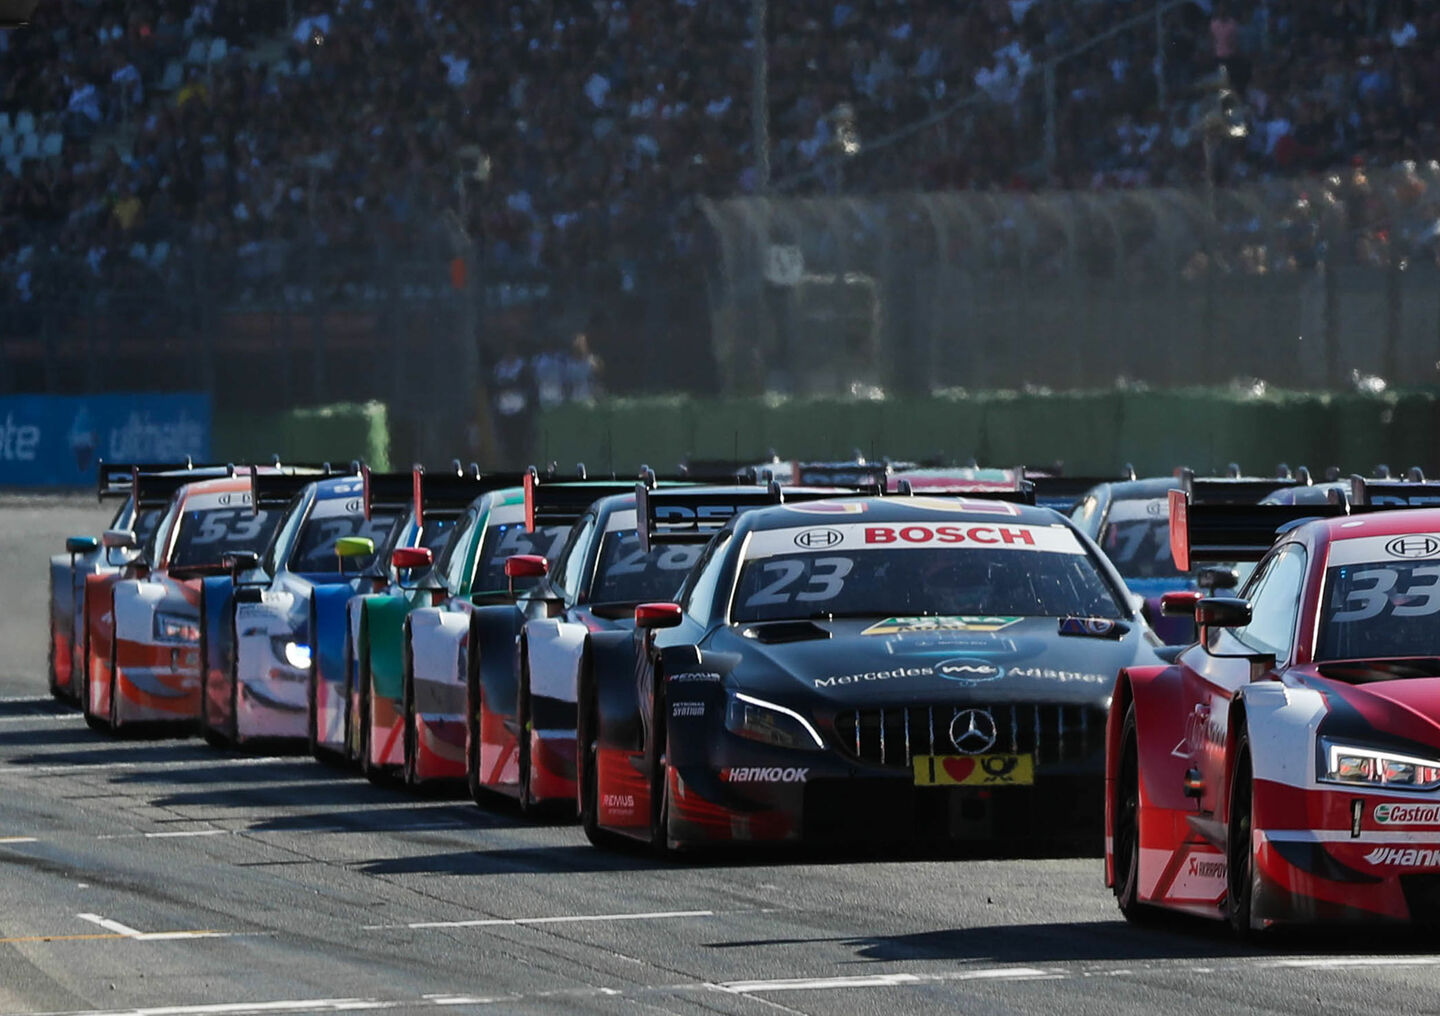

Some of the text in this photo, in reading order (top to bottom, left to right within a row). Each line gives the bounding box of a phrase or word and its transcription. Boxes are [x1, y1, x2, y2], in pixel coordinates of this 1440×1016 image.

[191, 511, 268, 544] 53
[864, 527, 1036, 545] BOSCH
[745, 557, 854, 607] 23
[814, 667, 934, 688] Mercedes
[1008, 666, 1106, 684] Adapter
[603, 794, 635, 807] REMUS
